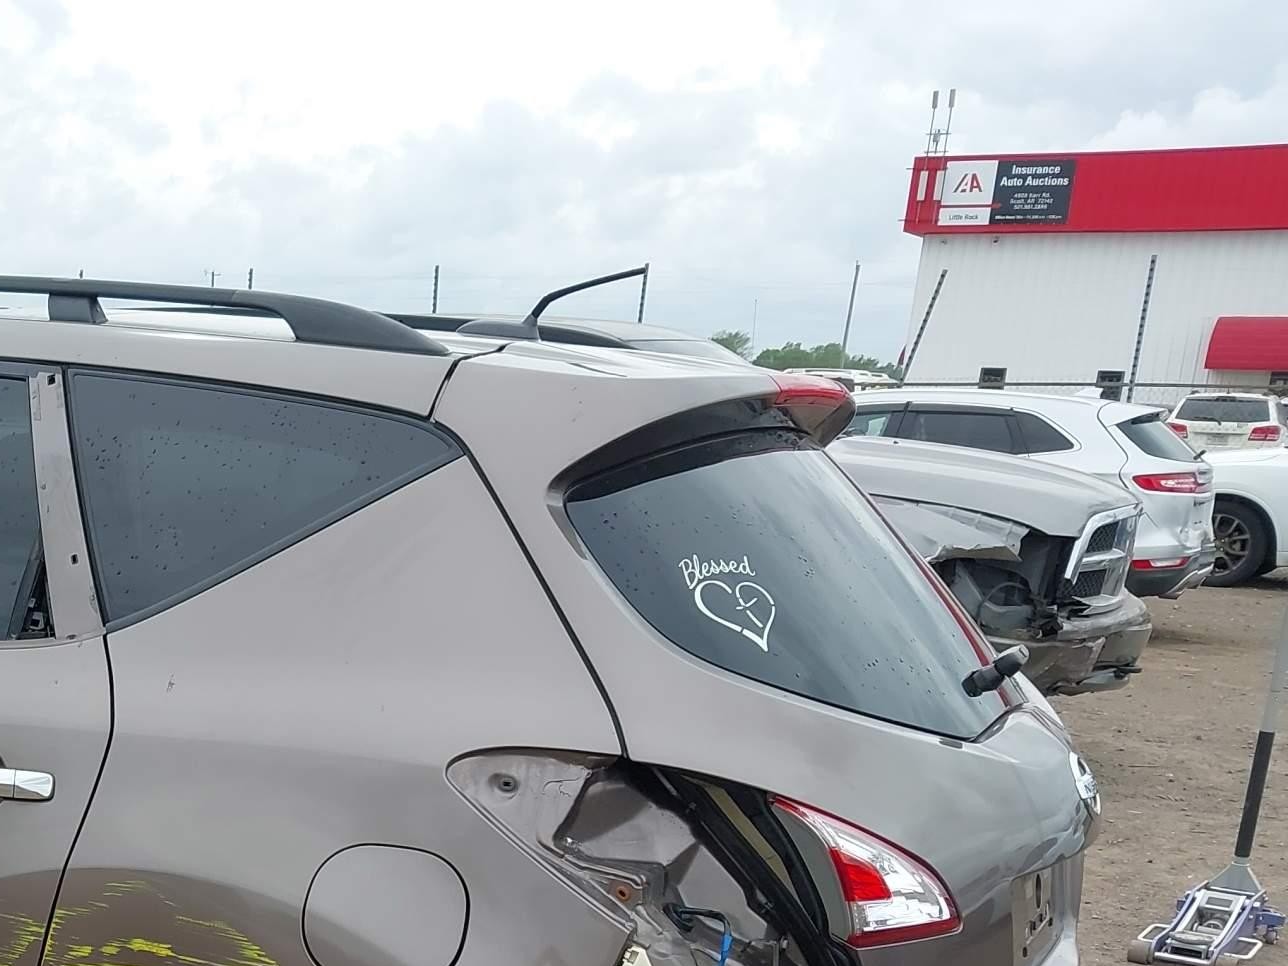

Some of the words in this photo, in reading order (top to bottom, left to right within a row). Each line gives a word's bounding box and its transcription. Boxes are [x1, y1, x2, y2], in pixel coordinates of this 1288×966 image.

[1012, 165, 1061, 175] Insurance
[1000, 177, 1024, 187] Auto
[1025, 176, 1070, 186] Auctions
[678, 554, 756, 589] Blessed
